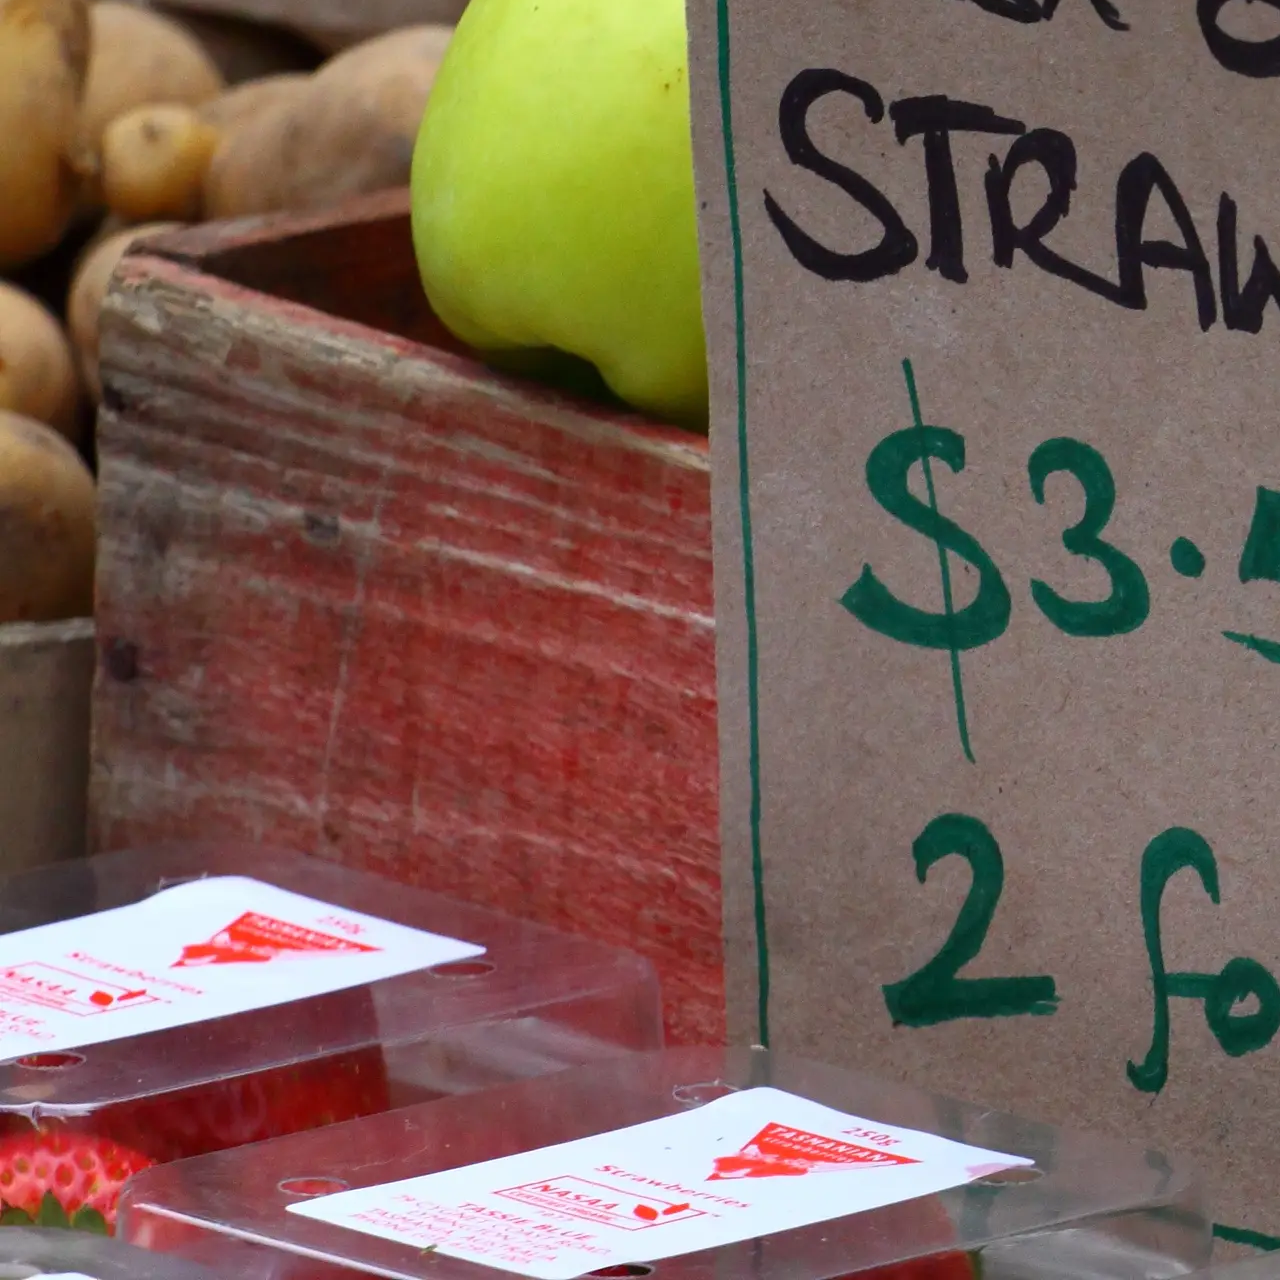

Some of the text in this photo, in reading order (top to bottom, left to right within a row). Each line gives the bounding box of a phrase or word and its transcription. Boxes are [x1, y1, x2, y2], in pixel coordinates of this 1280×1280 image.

[882, 812, 1060, 1028] 2
[764, 1126, 888, 1163] TASMANIAN
[840, 1126, 903, 1148] 250g
[529, 1184, 620, 1211] NASAA
[594, 1164, 752, 1209] Strawberries
